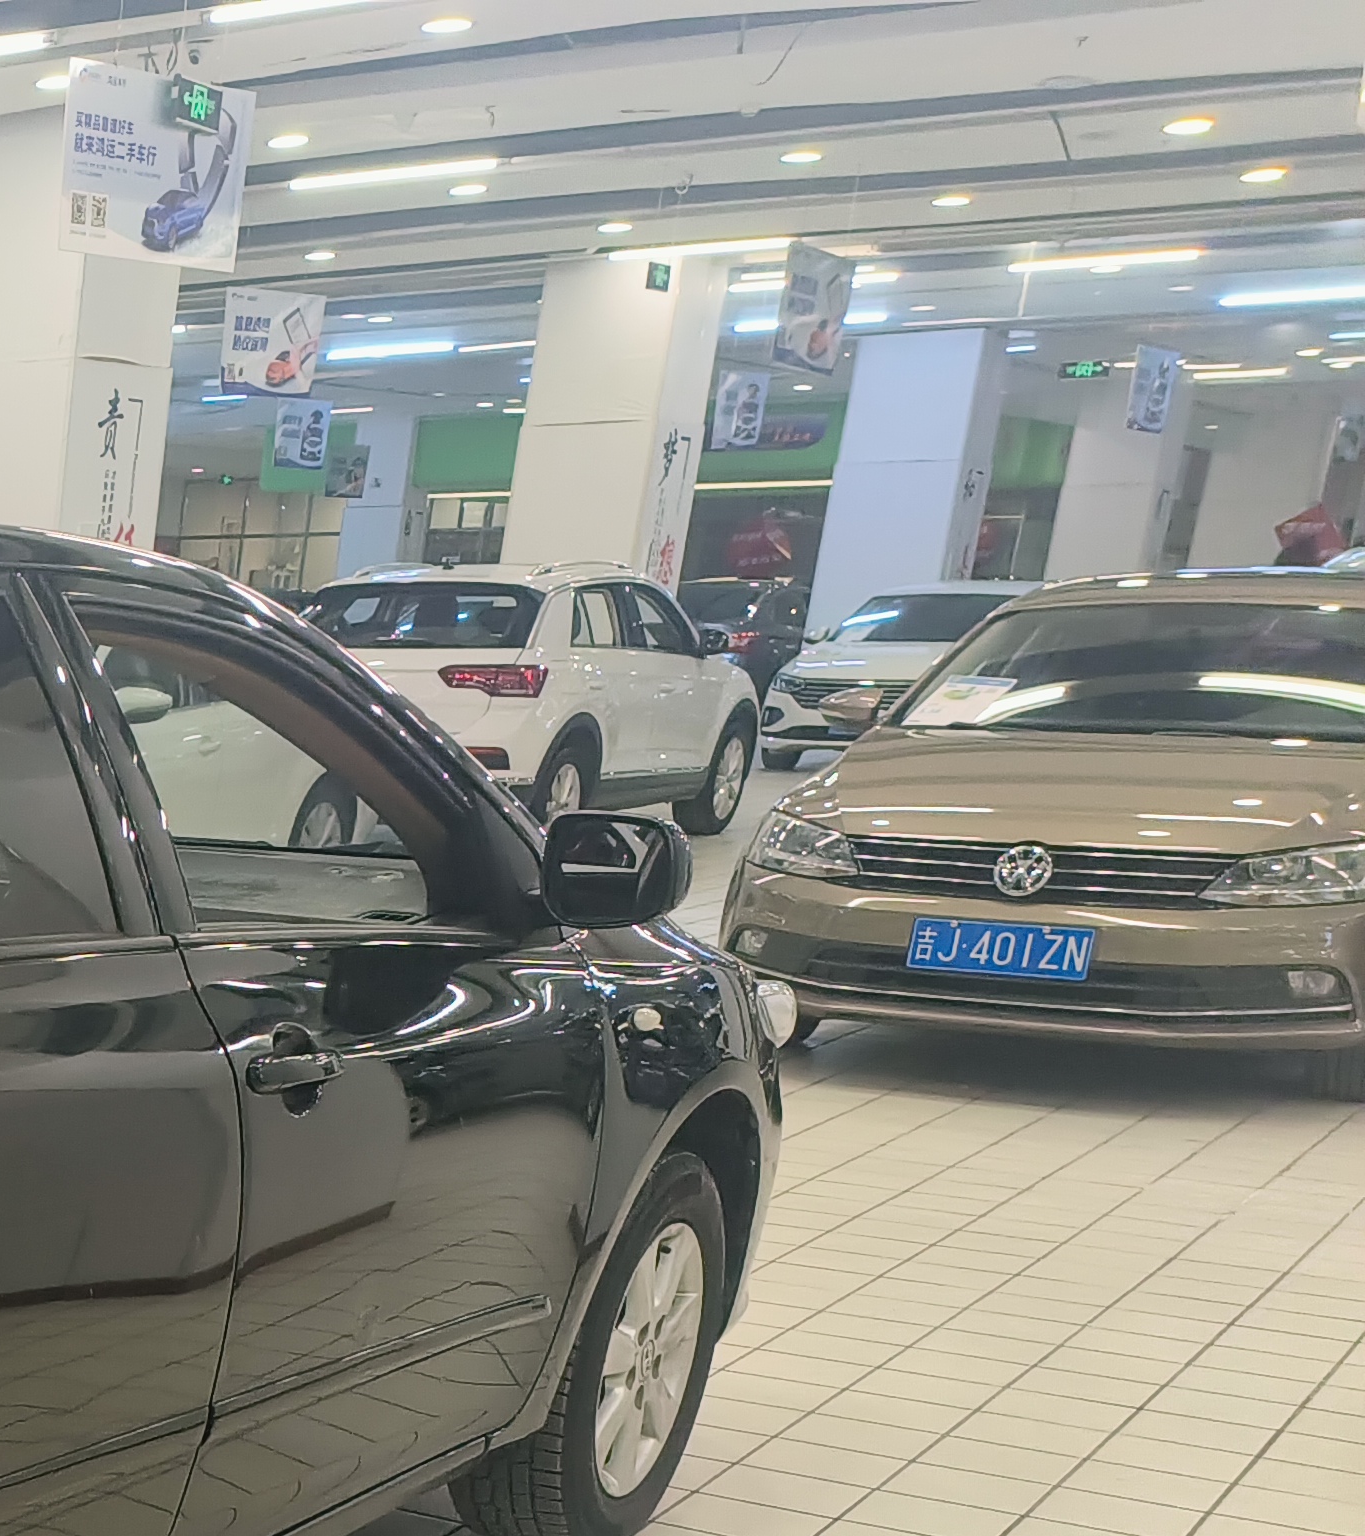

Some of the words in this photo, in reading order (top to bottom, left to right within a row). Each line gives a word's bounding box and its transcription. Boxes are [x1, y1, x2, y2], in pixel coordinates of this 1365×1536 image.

[73, 132, 158, 166] 就来鸿运二手车行
[97, 388, 124, 460] 责
